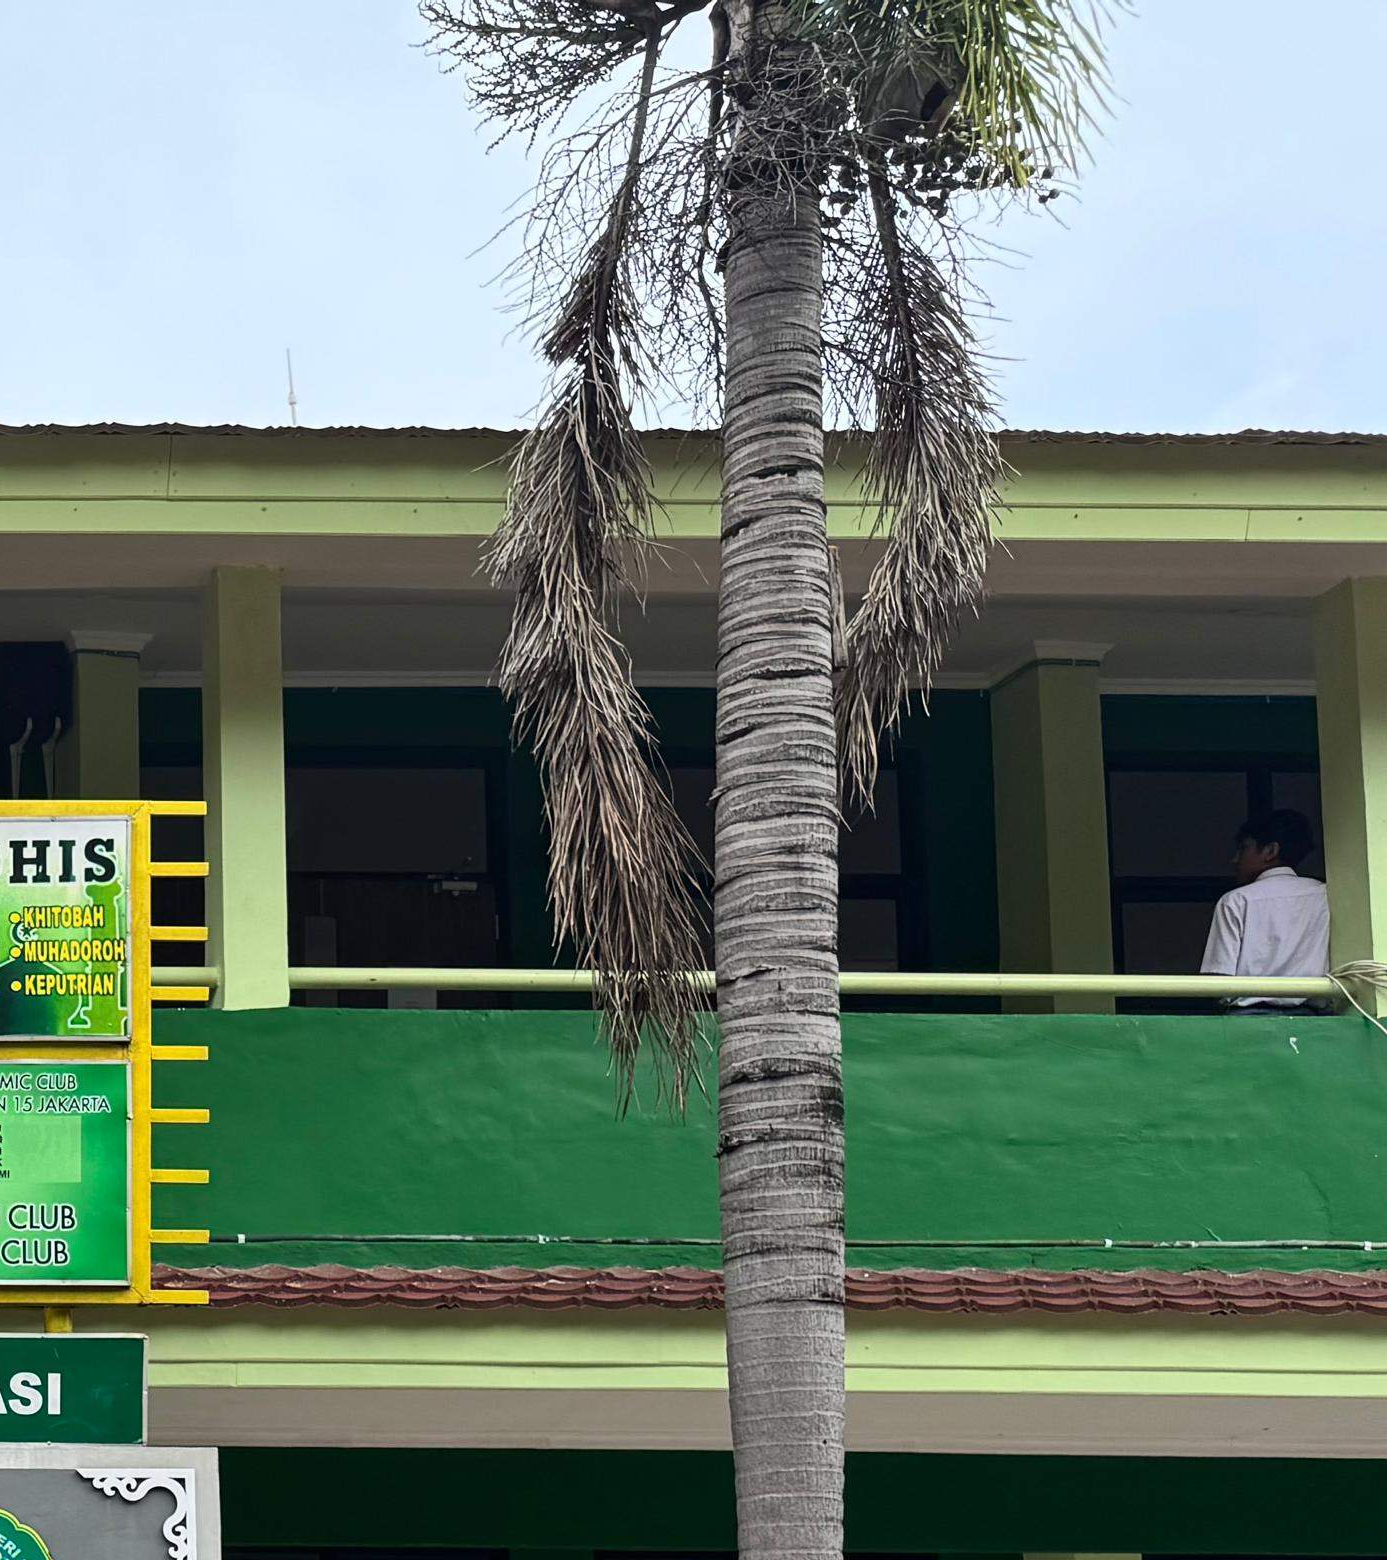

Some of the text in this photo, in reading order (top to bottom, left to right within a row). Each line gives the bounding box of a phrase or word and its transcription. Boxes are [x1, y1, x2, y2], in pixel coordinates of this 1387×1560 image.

[24, 906, 104, 927] KHITOBAH
[25, 941, 125, 961] MUHADOROH
[25, 975, 114, 995] KEPUTRIAN
[37, 1075, 76, 1089] CLUB
[15, 1097, 32, 1112] 15
[37, 1097, 110, 1112] JAKARTA
[8, 1205, 75, 1229] CLUB
[1, 1240, 69, 1264] CLUB
